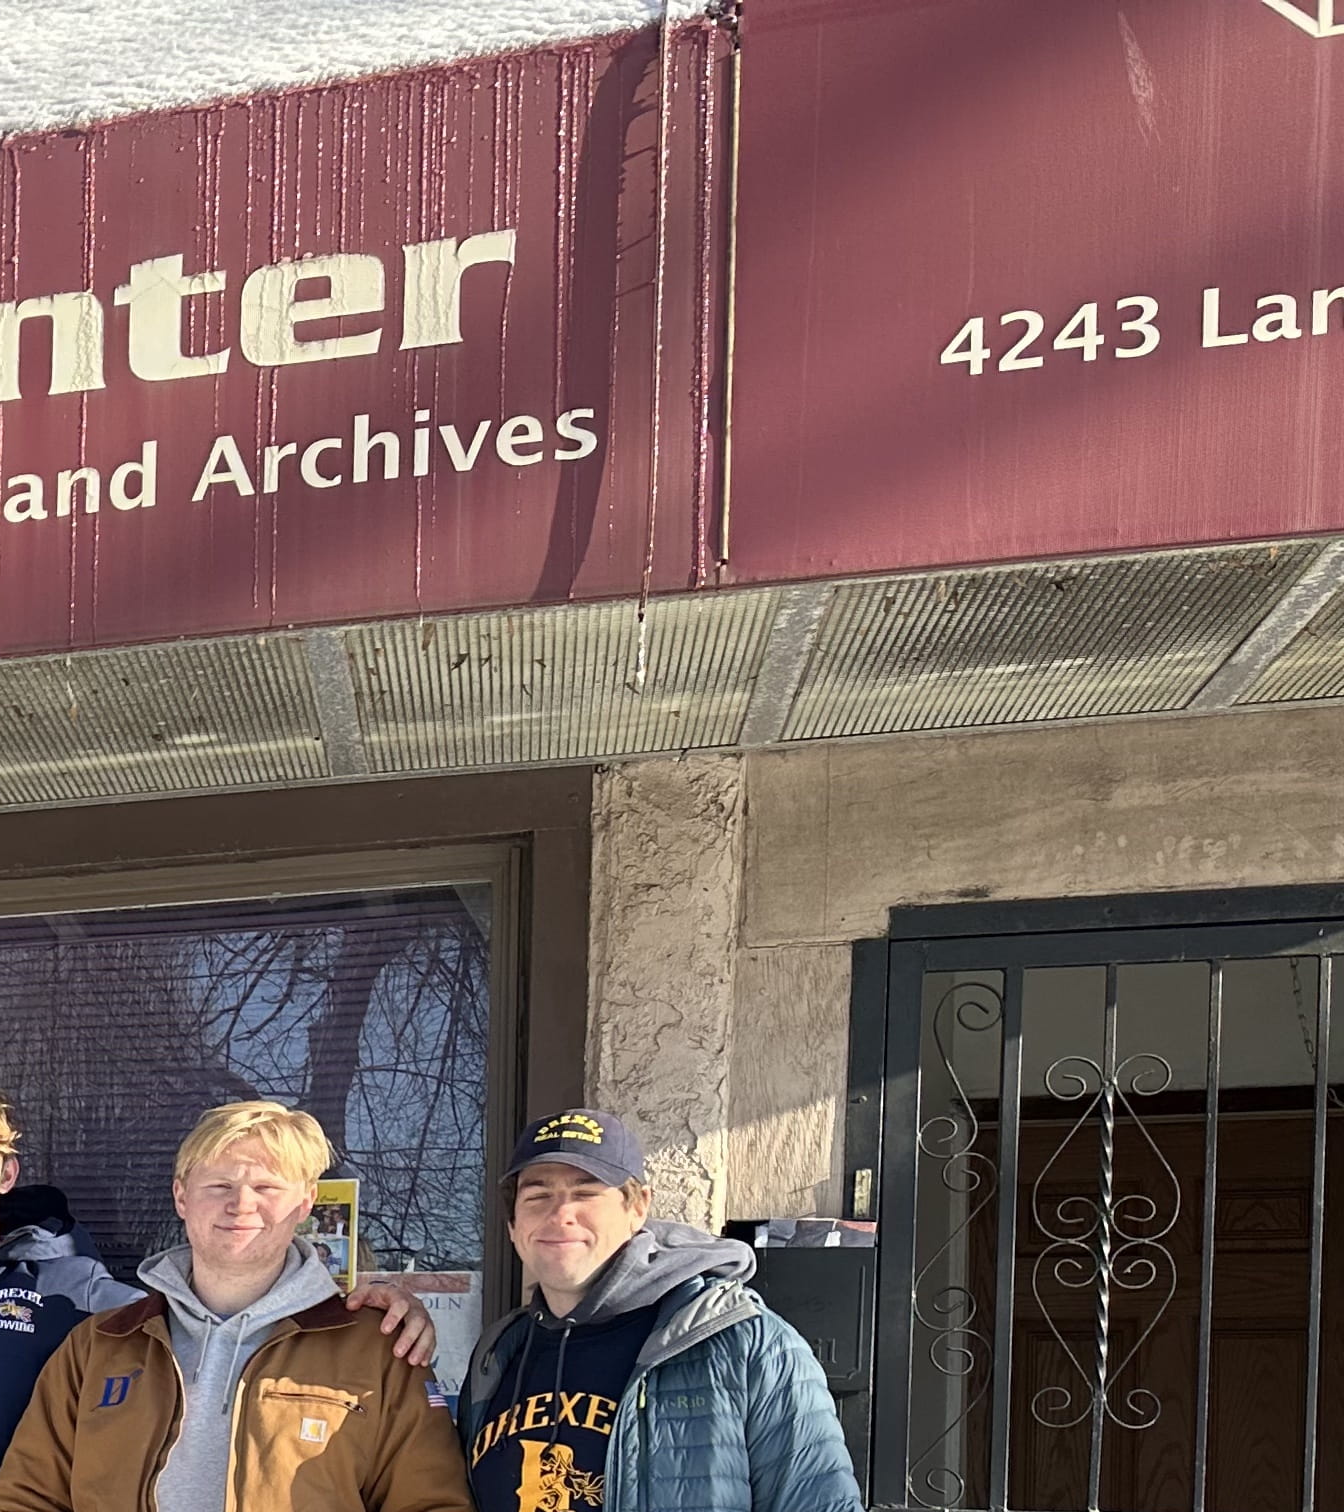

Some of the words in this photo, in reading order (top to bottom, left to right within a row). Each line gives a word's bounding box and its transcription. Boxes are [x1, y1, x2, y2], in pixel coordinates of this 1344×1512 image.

[941, 296, 1161, 376] 4243
[3, 440, 158, 524] and
[191, 408, 598, 503] Archives
[472, 1391, 617, 1470] DREXE
